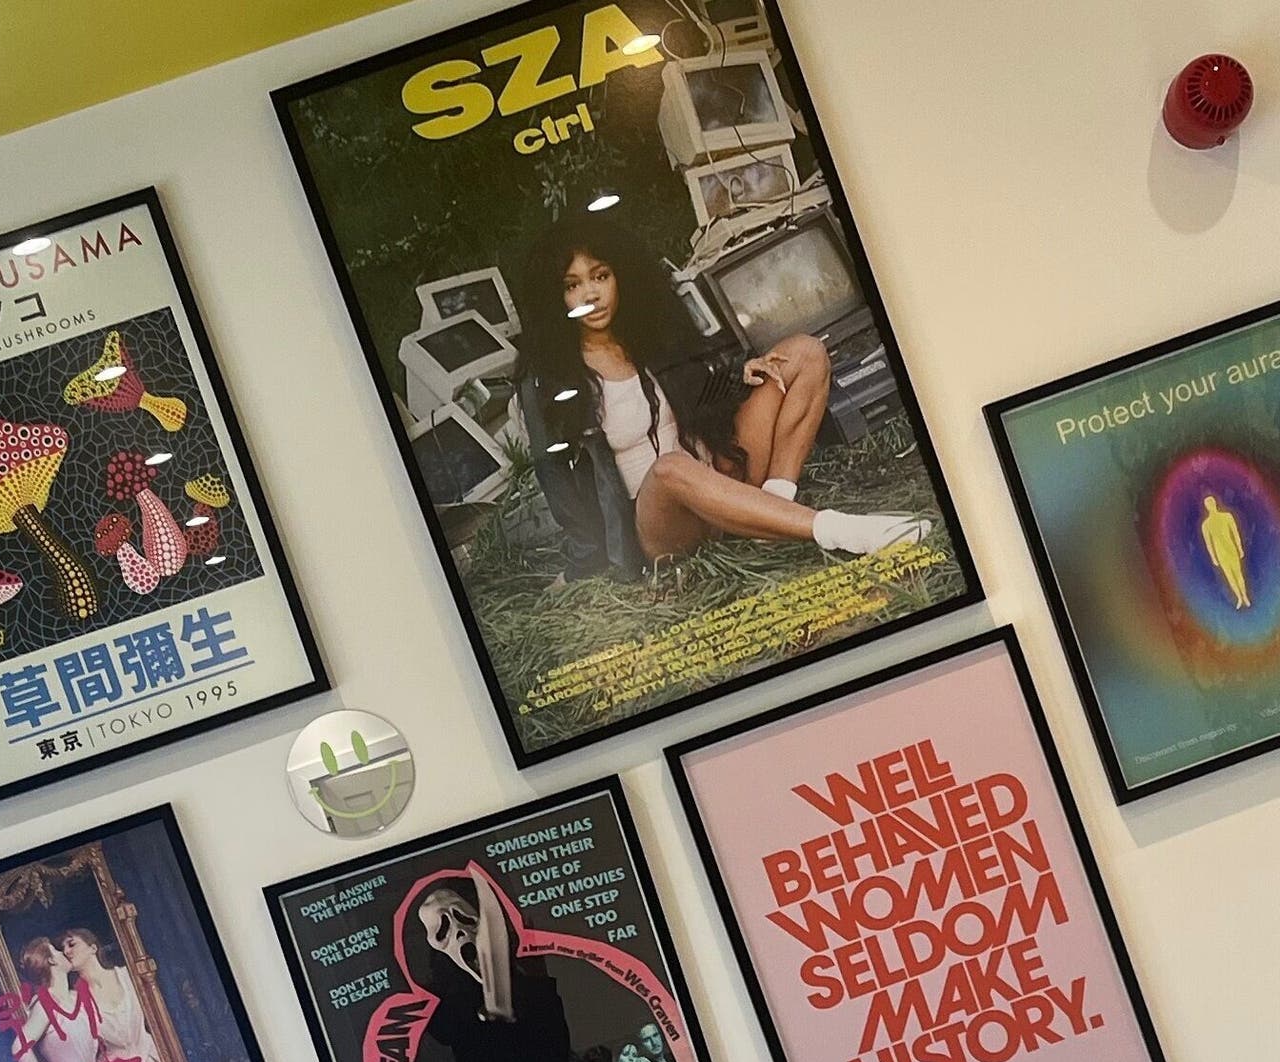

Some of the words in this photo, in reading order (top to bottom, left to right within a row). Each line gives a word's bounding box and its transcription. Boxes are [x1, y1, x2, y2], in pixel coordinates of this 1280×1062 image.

[401, 4, 664, 140] SZA
[513, 104, 594, 156] ctrl
[1055, 392, 1156, 445] Protect
[1158, 370, 1219, 415] your
[534, 680, 593, 709] GARDEN
[877, 550, 947, 583] ANYTHING
[546, 638, 642, 679] SUPERMODEL
[659, 618, 698, 639] LOVE
[611, 676, 668, 705] PRETTY
[719, 642, 762, 666] BIRDS
[785, 626, 805, 642] 20
[806, 595, 888, 634] SOMETHING
[620, 666, 663, 689] WAVY
[35, 730, 83, 760] 東京
[97, 702, 172, 740] TOKYO
[185, 681, 238, 711] 1995
[791, 738, 956, 826] WELL
[486, 827, 559, 858] SOMEONE
[561, 818, 593, 837] HAS
[497, 850, 548, 874] TAKEN
[549, 838, 595, 859] THEIR
[762, 773, 1028, 906] BEHAVED
[518, 884, 566, 908] SCARY
[569, 867, 626, 895] MOVIES
[522, 866, 560, 887] LOVE
[562, 860, 582, 875] OF
[766, 820, 1052, 954] WOMEN
[300, 895, 338, 917] DON'T
[339, 875, 387, 902] ANSWER
[310, 909, 334, 924] THE
[335, 891, 375, 914] PHONE
[550, 899, 583, 919] ONE
[585, 889, 619, 909] STEP
[585, 910, 618, 928] TOO
[607, 924, 638, 943] FAR
[311, 938, 346, 960] DON'T
[348, 925, 380, 942] OPEN
[320, 952, 344, 967] THE
[344, 938, 378, 958] DOOR
[800, 872, 1069, 1010] SELDOM
[329, 976, 366, 999] DON'T
[366, 968, 388, 983] TRY
[332, 996, 349, 1009] TO
[350, 979, 390, 1001] ESCAPE
[529, 942, 555, 952] brand
[557, 946, 575, 955] new
[576, 950, 605, 963] thriller
[605, 960, 624, 977] from
[624, 969, 651, 997] Wes
[649, 995, 680, 1042] Craven
[858, 937, 1054, 1055] MAKE
